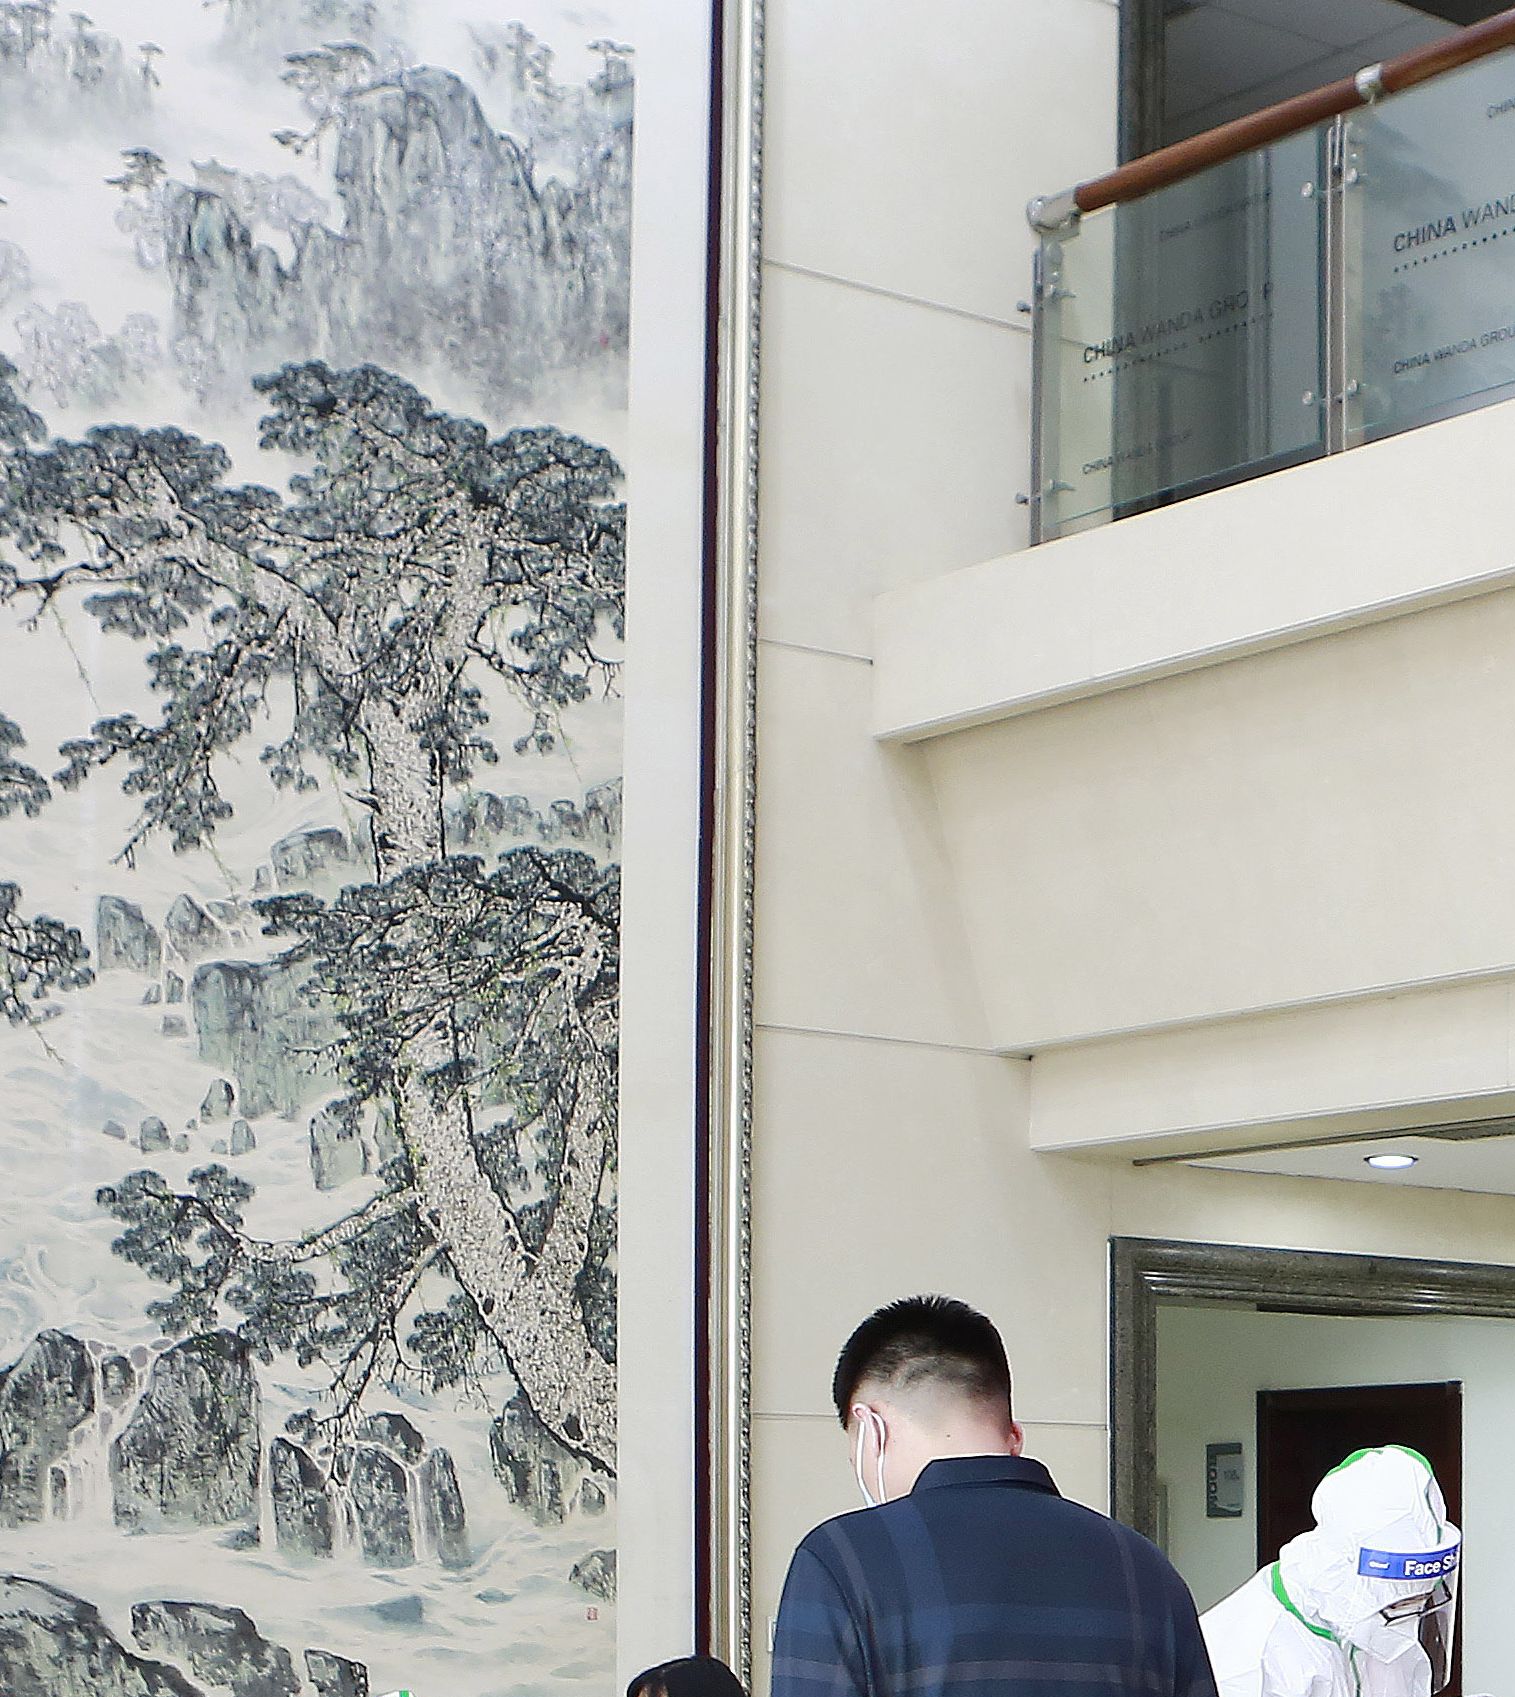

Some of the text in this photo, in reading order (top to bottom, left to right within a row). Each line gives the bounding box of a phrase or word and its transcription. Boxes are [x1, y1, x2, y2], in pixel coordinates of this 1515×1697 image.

[1393, 215, 1457, 252] CHINA
[1393, 352, 1430, 374] CHINA
[1403, 1560, 1442, 1576] Face
